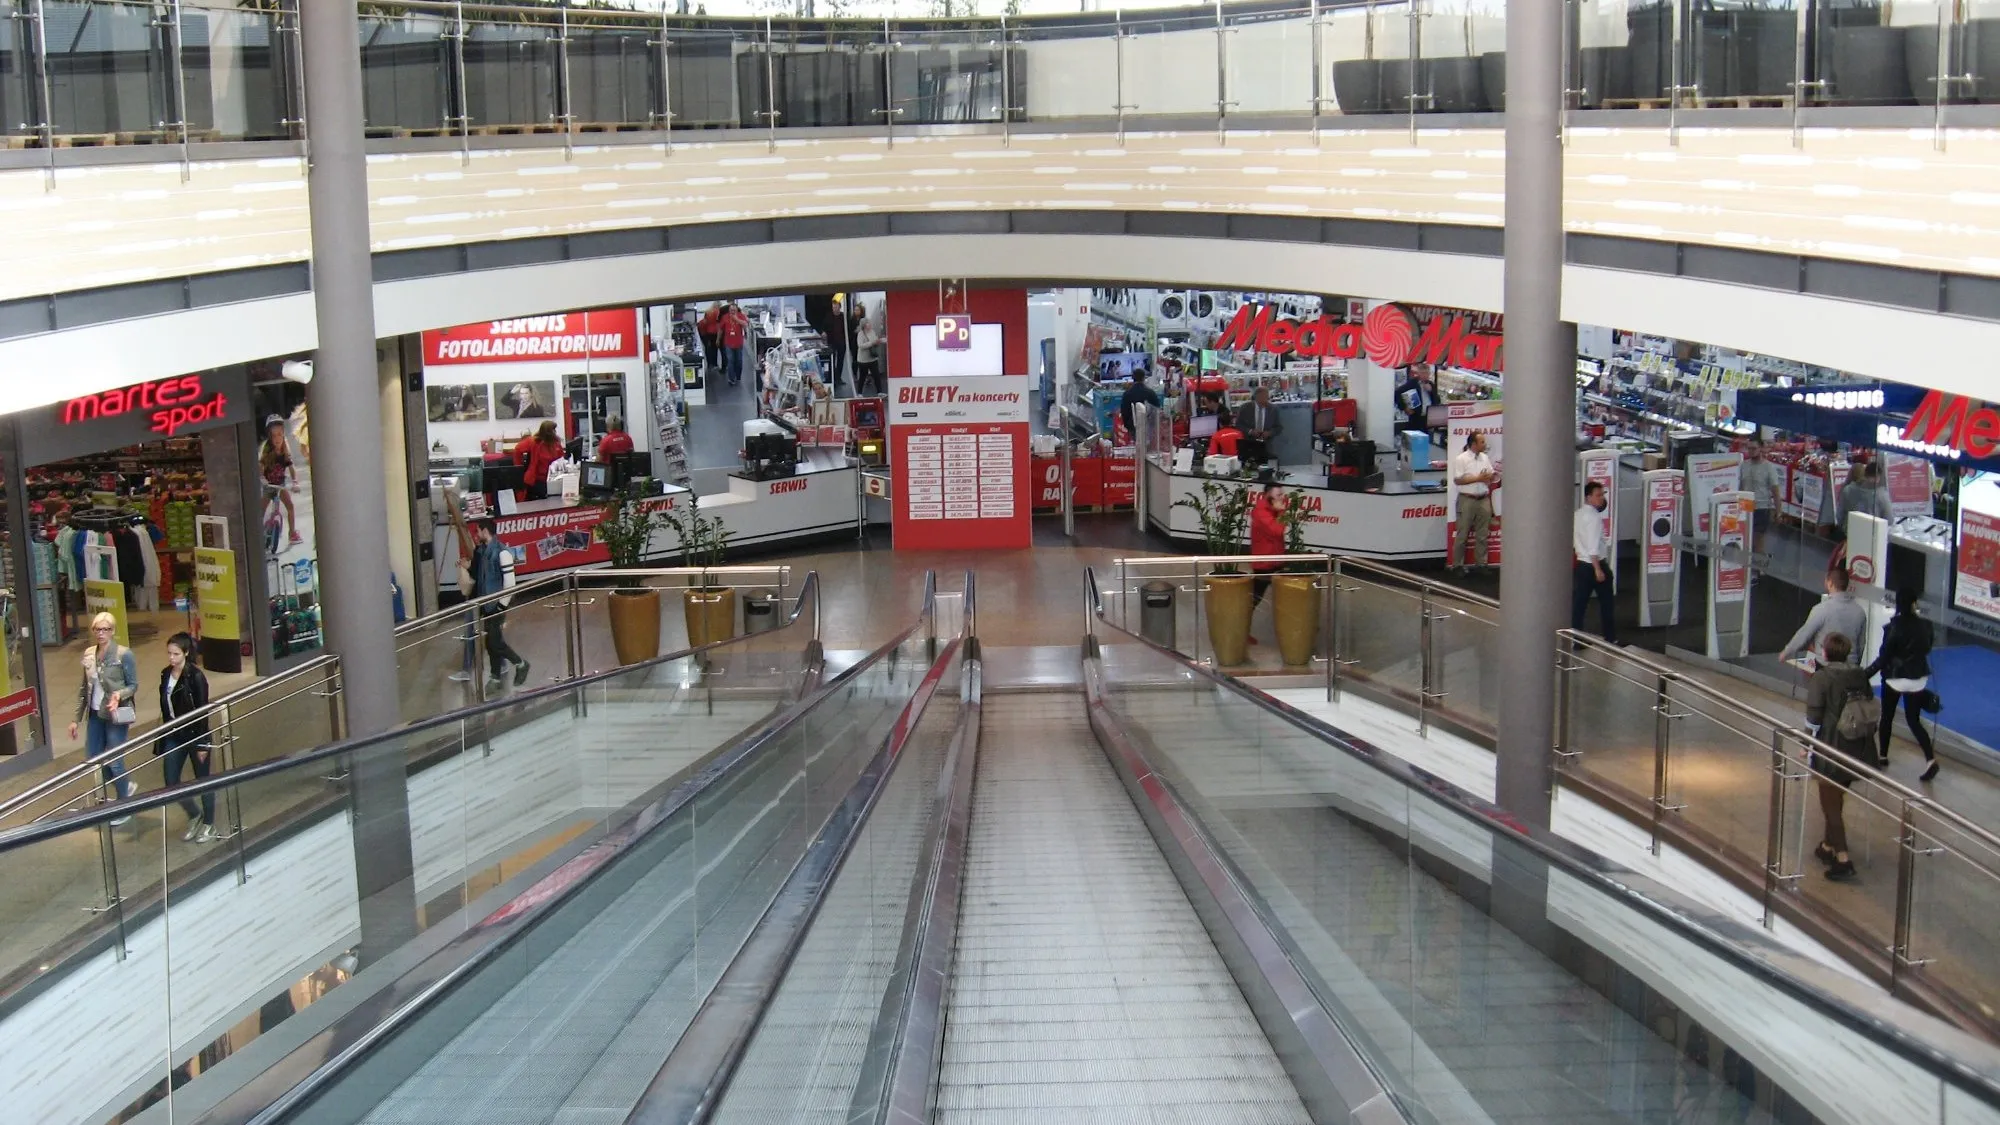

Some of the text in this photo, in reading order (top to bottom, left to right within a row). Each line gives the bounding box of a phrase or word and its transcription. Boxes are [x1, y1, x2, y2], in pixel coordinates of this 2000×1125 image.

[1215, 303, 1363, 358] Media
[438, 333, 622, 359] FOTOLABORATORIUM
[64, 375, 203, 425] martes
[898, 386, 1020, 404] BILETY na koncerty
[150, 393, 228, 436] sport
[1453, 428, 1463, 436] 40
[769, 478, 808, 495] SERWIS
[496, 519, 538, 535] USŁUGI
[538, 512, 569, 529] FOTO
